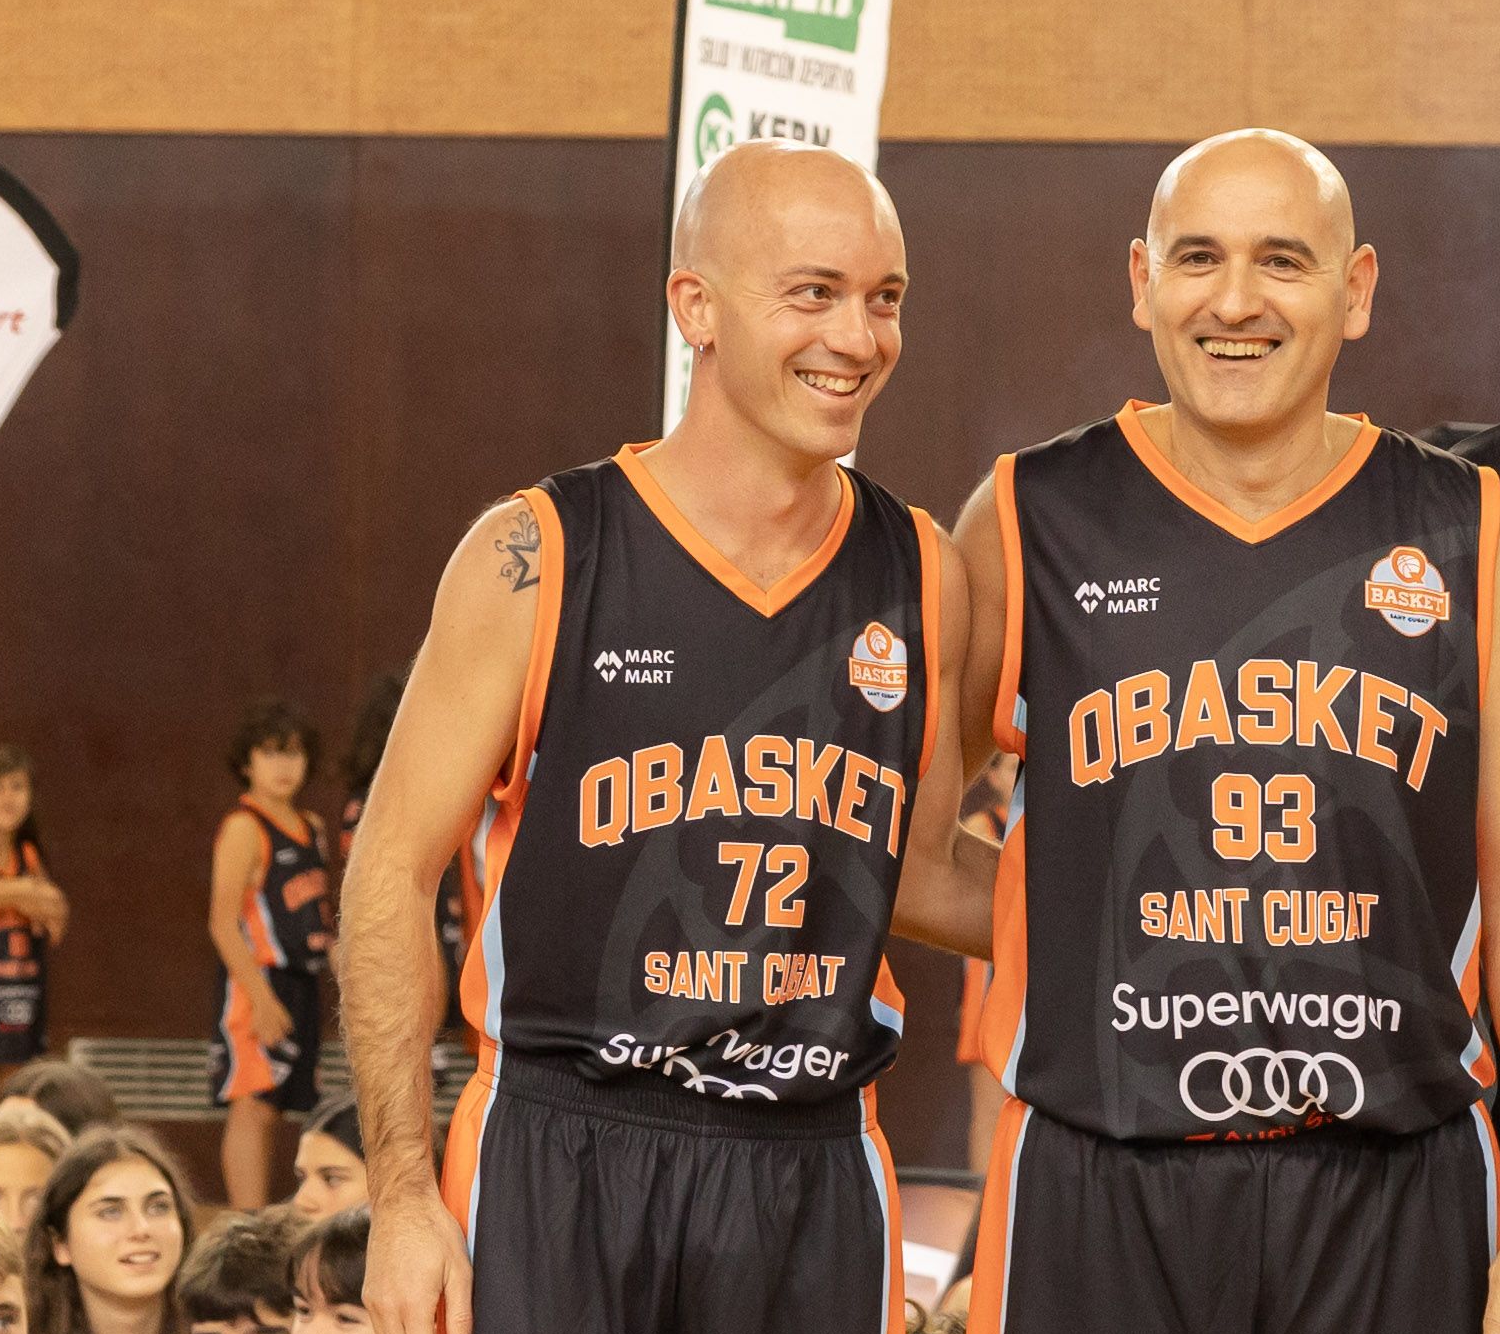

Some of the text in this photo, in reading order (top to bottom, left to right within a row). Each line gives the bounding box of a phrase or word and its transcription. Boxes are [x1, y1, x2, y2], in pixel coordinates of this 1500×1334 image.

[1107, 577, 1161, 595] MARC
[1107, 597, 1160, 615] MART
[1371, 587, 1444, 613] BASKET
[625, 649, 675, 665] MARC
[625, 669, 674, 685] MART
[1068, 658, 1449, 793] QBASKET
[579, 734, 906, 859] QBASKET
[1211, 772, 1318, 864] 93
[718, 841, 811, 929] 72
[1140, 888, 1380, 948] SANT CUGAT
[644, 950, 748, 1004] SANT
